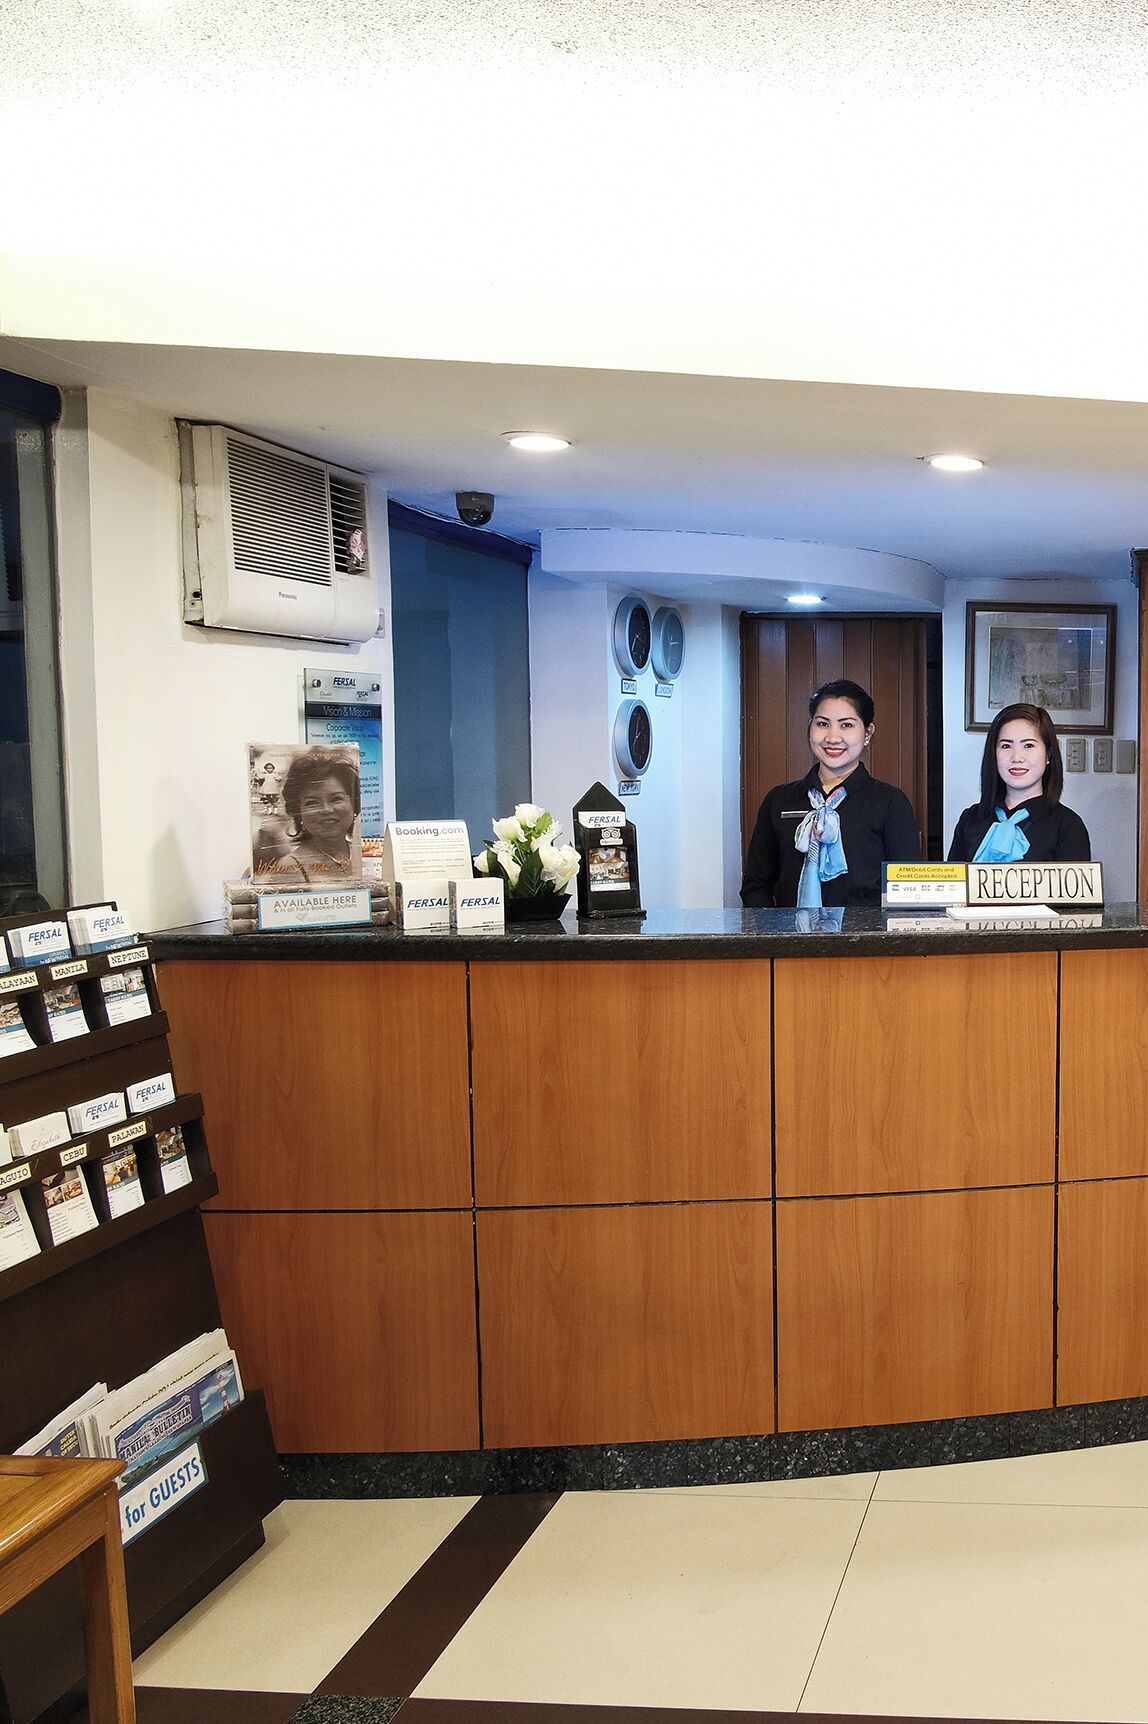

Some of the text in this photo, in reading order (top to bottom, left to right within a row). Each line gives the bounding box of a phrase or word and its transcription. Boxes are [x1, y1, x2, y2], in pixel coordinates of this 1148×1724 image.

[278, 591, 297, 600] Panasonic
[333, 677, 356, 687] FERSAL
[588, 816, 621, 824] FERSAL
[395, 827, 465, 836] Booking.com
[976, 867, 1095, 899] RECEPTION
[274, 895, 357, 908] AVAILABLE HERE
[407, 898, 449, 909] FERSAL
[460, 896, 501, 908] FERSAL
[93, 916, 124, 929] FERSAL
[28, 928, 62, 942] FERSAL
[111, 950, 147, 964] NEPTUNE
[54, 963, 86, 978] MANILA
[136, 1082, 166, 1100] FERSAL
[85, 1099, 119, 1117] FERSAL
[111, 1124, 145, 1143] PALAWAN
[63, 1147, 85, 1162] CEBU
[119, 1434, 151, 1460] MANILA
[153, 1405, 192, 1438] BULLETIN
[124, 1456, 201, 1529] for GUESTS
